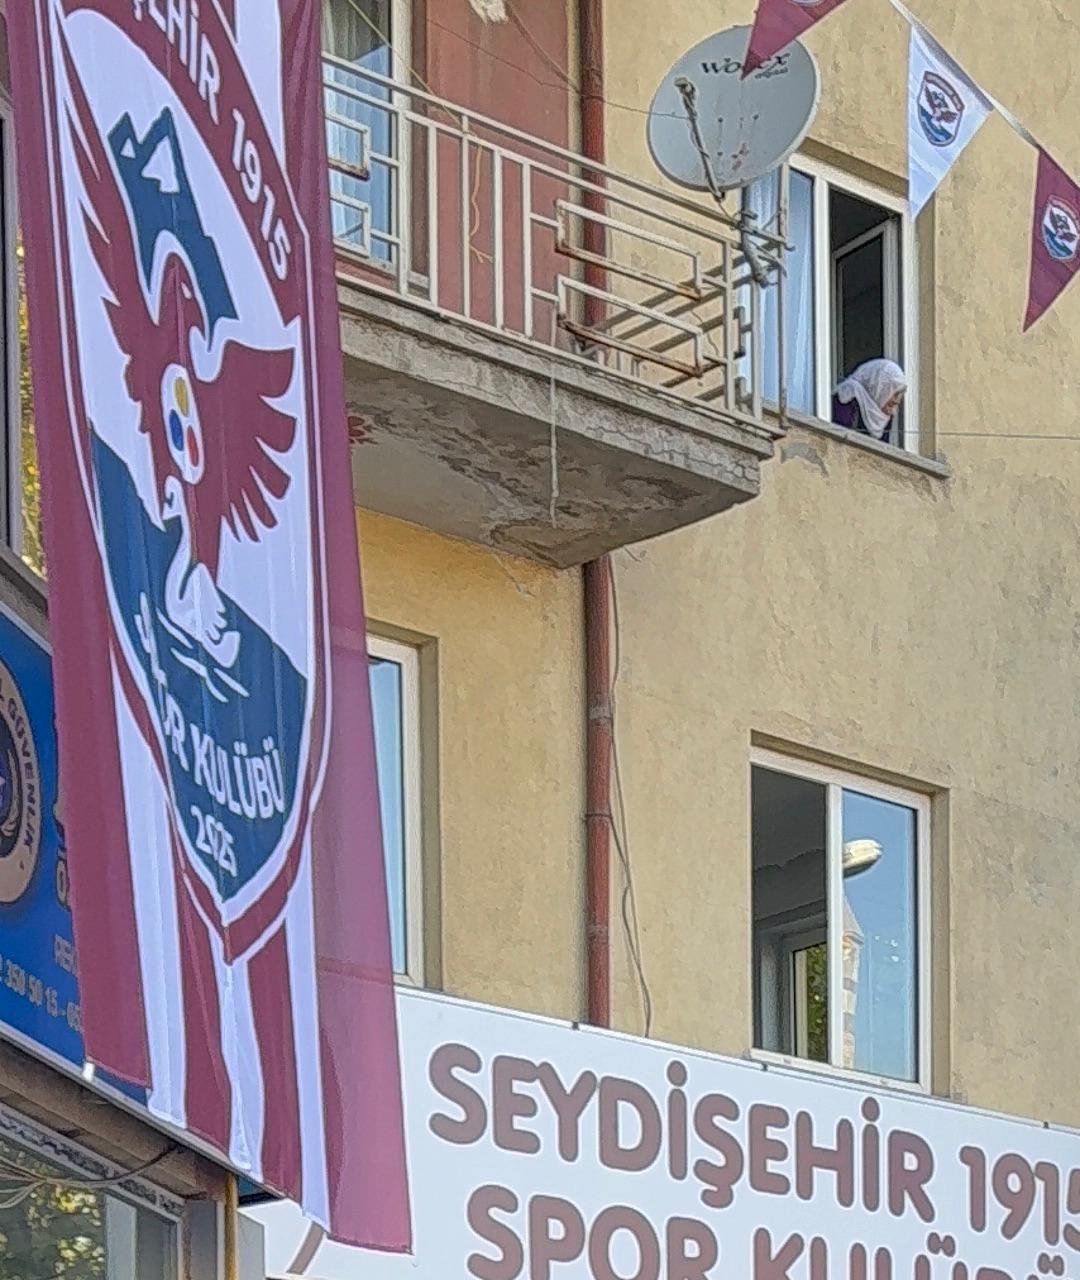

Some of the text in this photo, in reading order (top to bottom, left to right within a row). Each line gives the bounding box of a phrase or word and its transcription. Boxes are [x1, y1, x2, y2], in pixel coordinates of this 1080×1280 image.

[232, 108, 291, 281] 1915
[189, 722, 286, 820] KULÜBÜ
[428, 1042, 936, 1224] SEYDİŞEHİR
